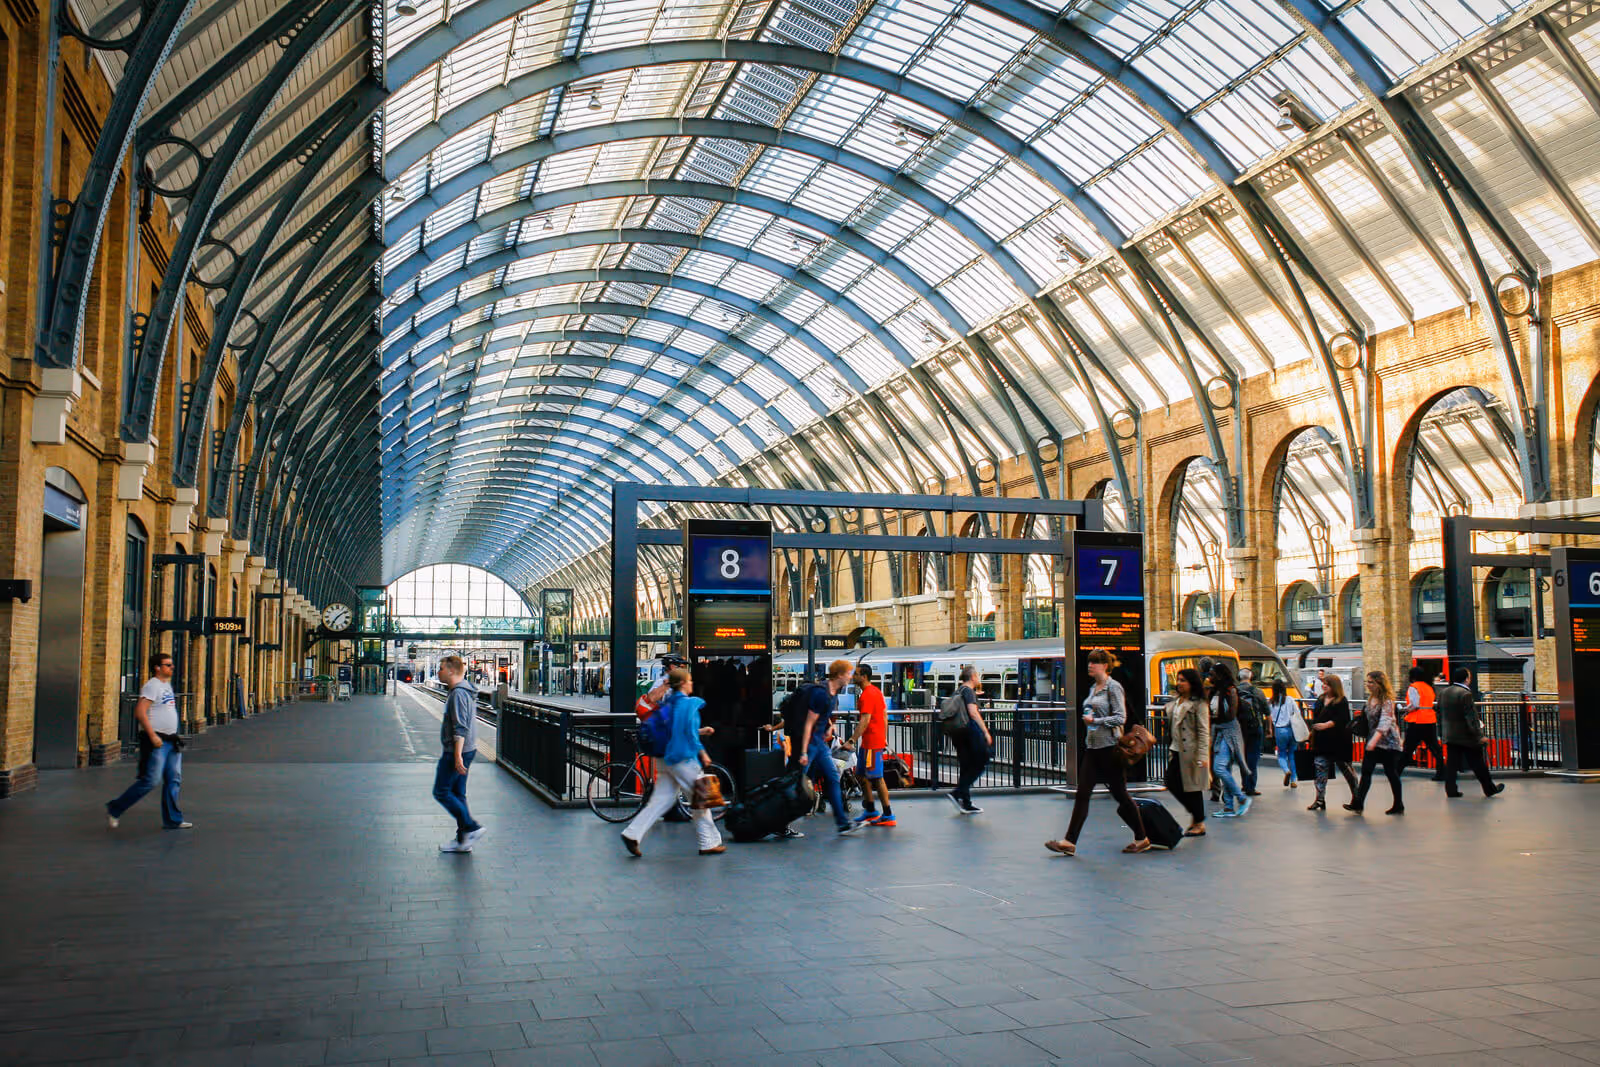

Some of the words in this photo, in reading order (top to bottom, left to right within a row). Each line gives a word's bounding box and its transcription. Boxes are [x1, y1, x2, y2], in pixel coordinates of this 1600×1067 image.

[721, 549, 740, 578] 8
[1064, 557, 1072, 576] 7
[1101, 560, 1117, 585] 7
[1554, 569, 1565, 587] 6
[1589, 571, 1600, 596] 6
